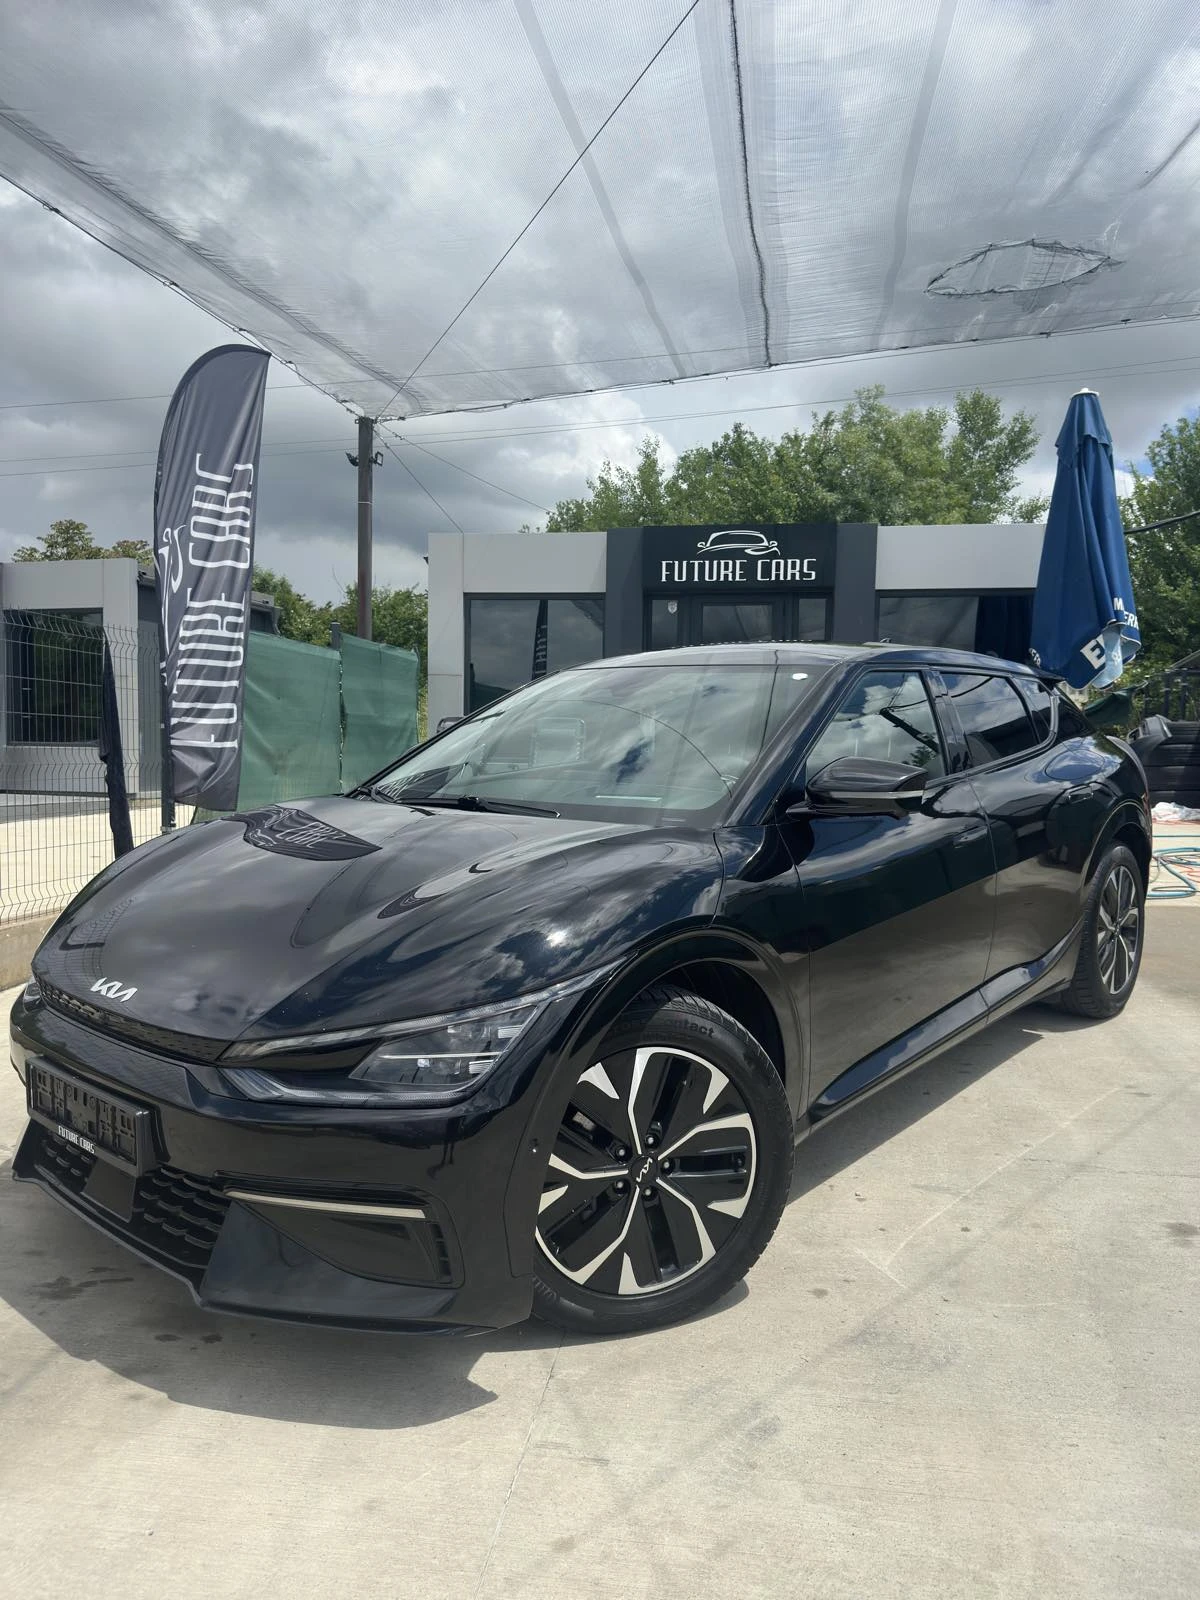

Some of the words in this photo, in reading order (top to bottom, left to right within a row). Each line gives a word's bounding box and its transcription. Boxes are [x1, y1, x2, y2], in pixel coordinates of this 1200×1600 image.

[189, 453, 253, 569] CARS
[661, 559, 747, 582] FUTURE
[756, 558, 816, 581] CARS
[170, 587, 245, 748] FUTURE
[90, 977, 138, 1003] KIA
[58, 1125, 79, 1144] FUTURE
[79, 1137, 96, 1154] CARS
